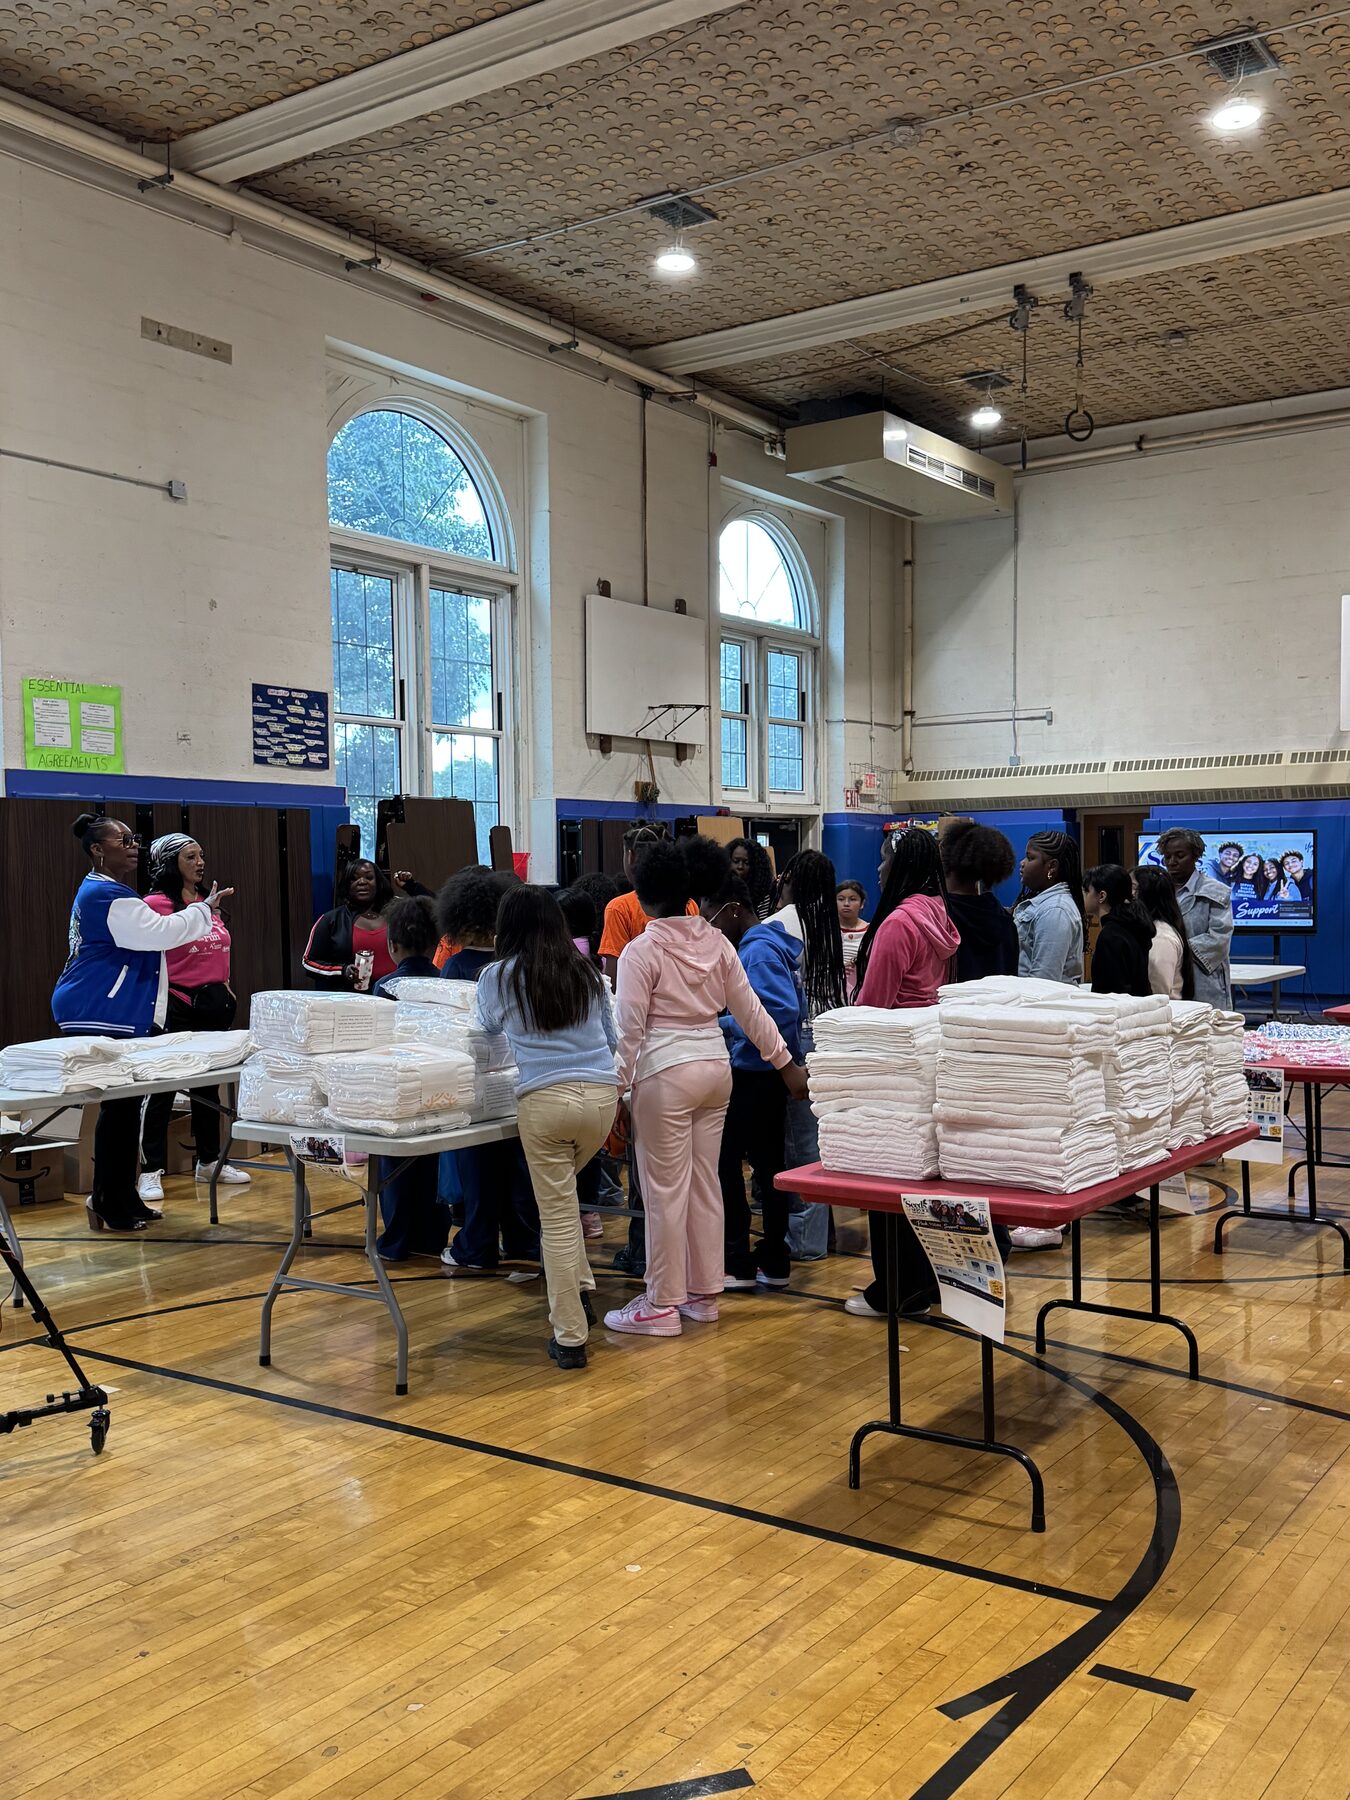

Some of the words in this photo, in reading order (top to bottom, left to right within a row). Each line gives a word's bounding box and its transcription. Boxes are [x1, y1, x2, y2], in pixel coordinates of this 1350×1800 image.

[28, 679, 88, 694] ESSENTIAL
[37, 754, 109, 771] AGREEMENTS
[864, 774, 876, 788] EXIT
[846, 790, 859, 807] EXIT
[1236, 902, 1279, 918] Support
[905, 1199, 928, 1210] Seeds
